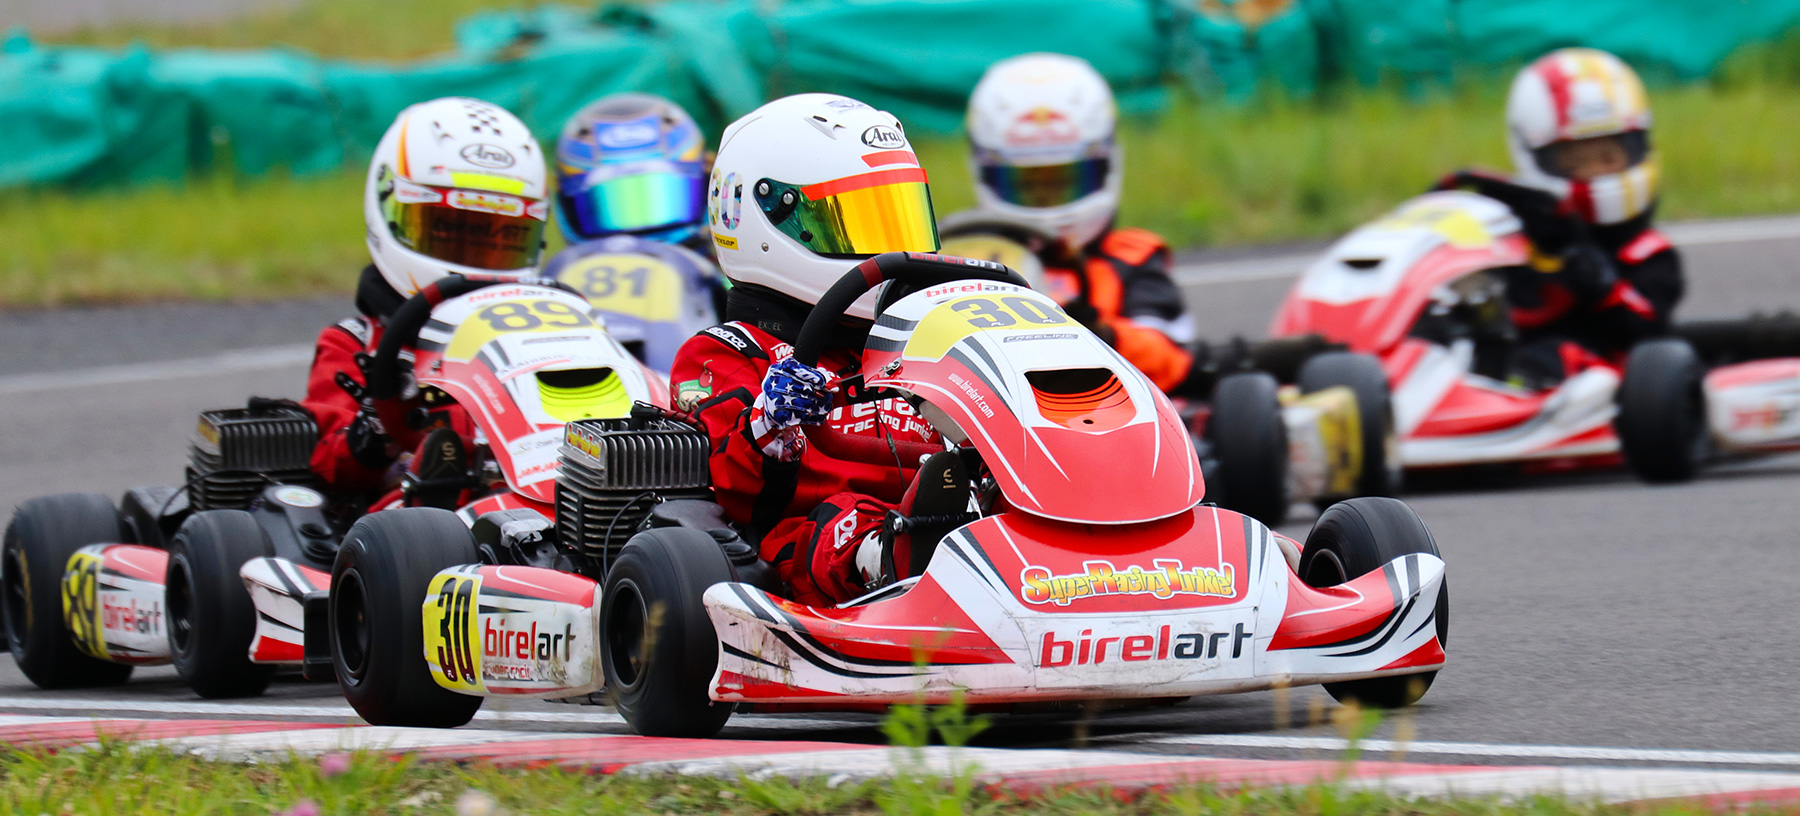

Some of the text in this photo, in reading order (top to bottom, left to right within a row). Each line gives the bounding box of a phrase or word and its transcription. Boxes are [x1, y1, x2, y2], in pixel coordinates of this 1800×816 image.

[868, 127, 903, 145] Arai
[583, 266, 650, 298] 81
[479, 301, 594, 332] 89
[951, 296, 1068, 329] 30
[706, 326, 747, 350] sparco
[437, 577, 477, 686] 30
[484, 617, 577, 662] birelart
[1039, 622, 1254, 669] birelart
